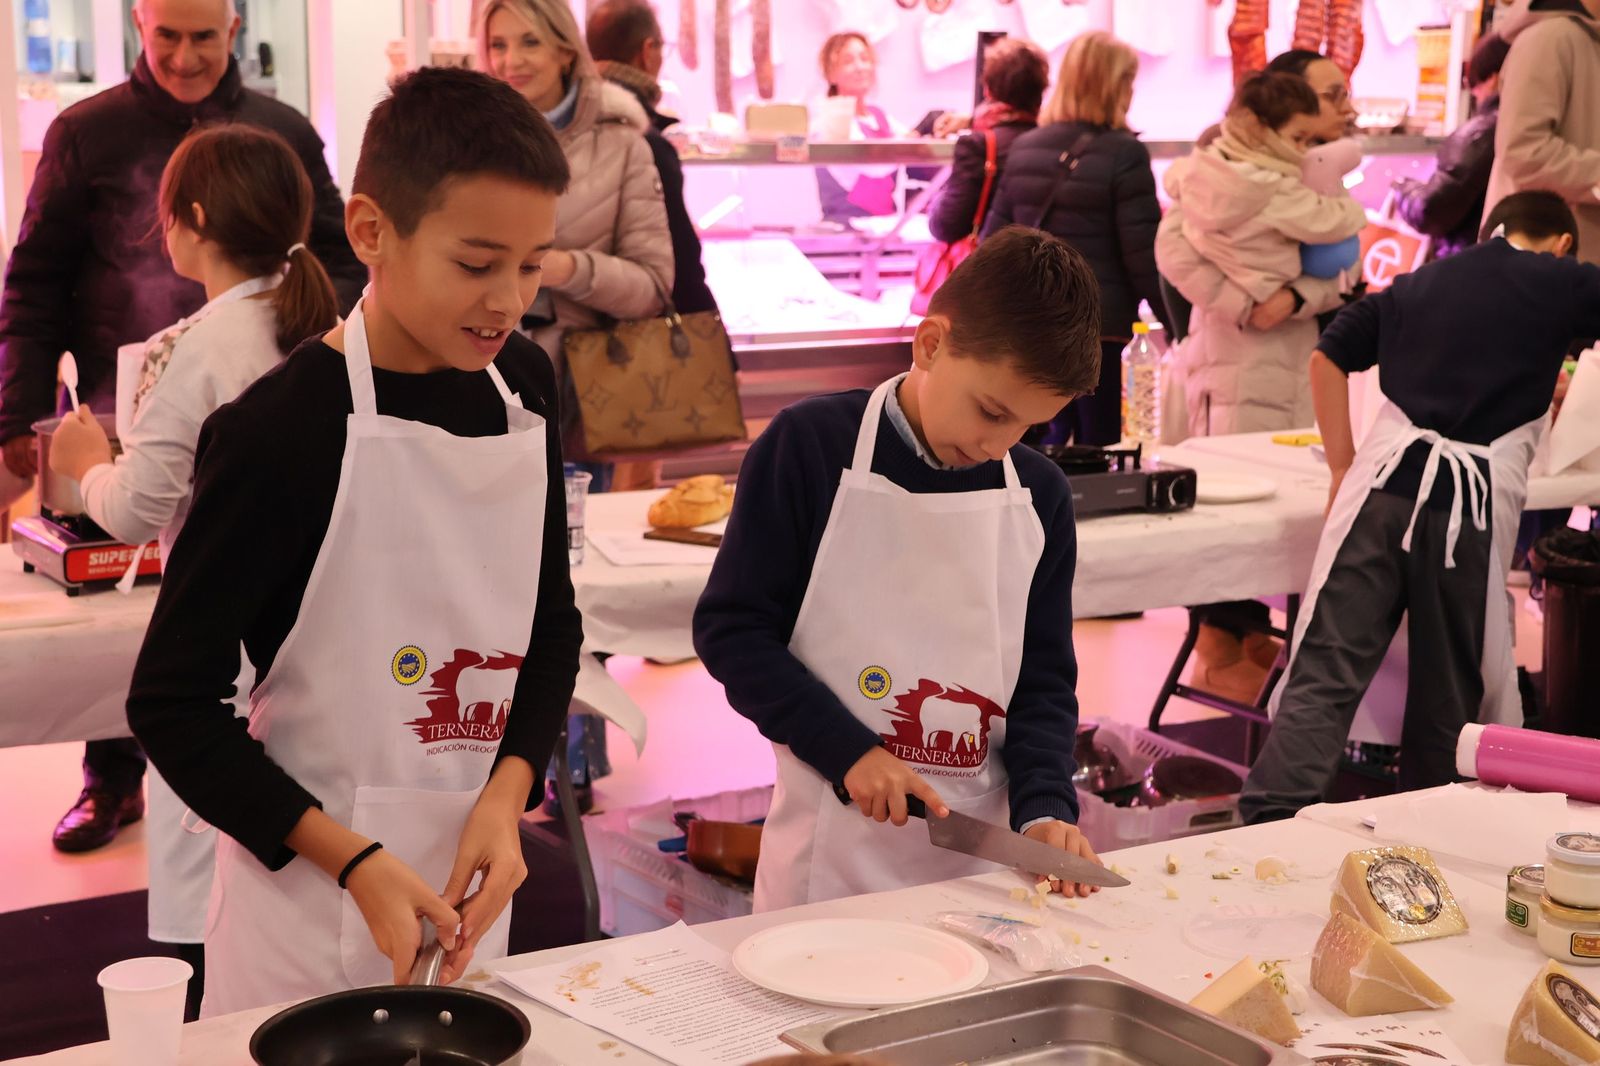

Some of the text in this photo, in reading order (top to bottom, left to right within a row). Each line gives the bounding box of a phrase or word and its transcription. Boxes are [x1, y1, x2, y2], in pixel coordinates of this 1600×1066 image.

[427, 722, 500, 739] TERNERA
[426, 743, 499, 756] INDICACIÓN GEOGR
[892, 743, 961, 765] TERNERA
[932, 769, 977, 778] GEOGRÁFICA
